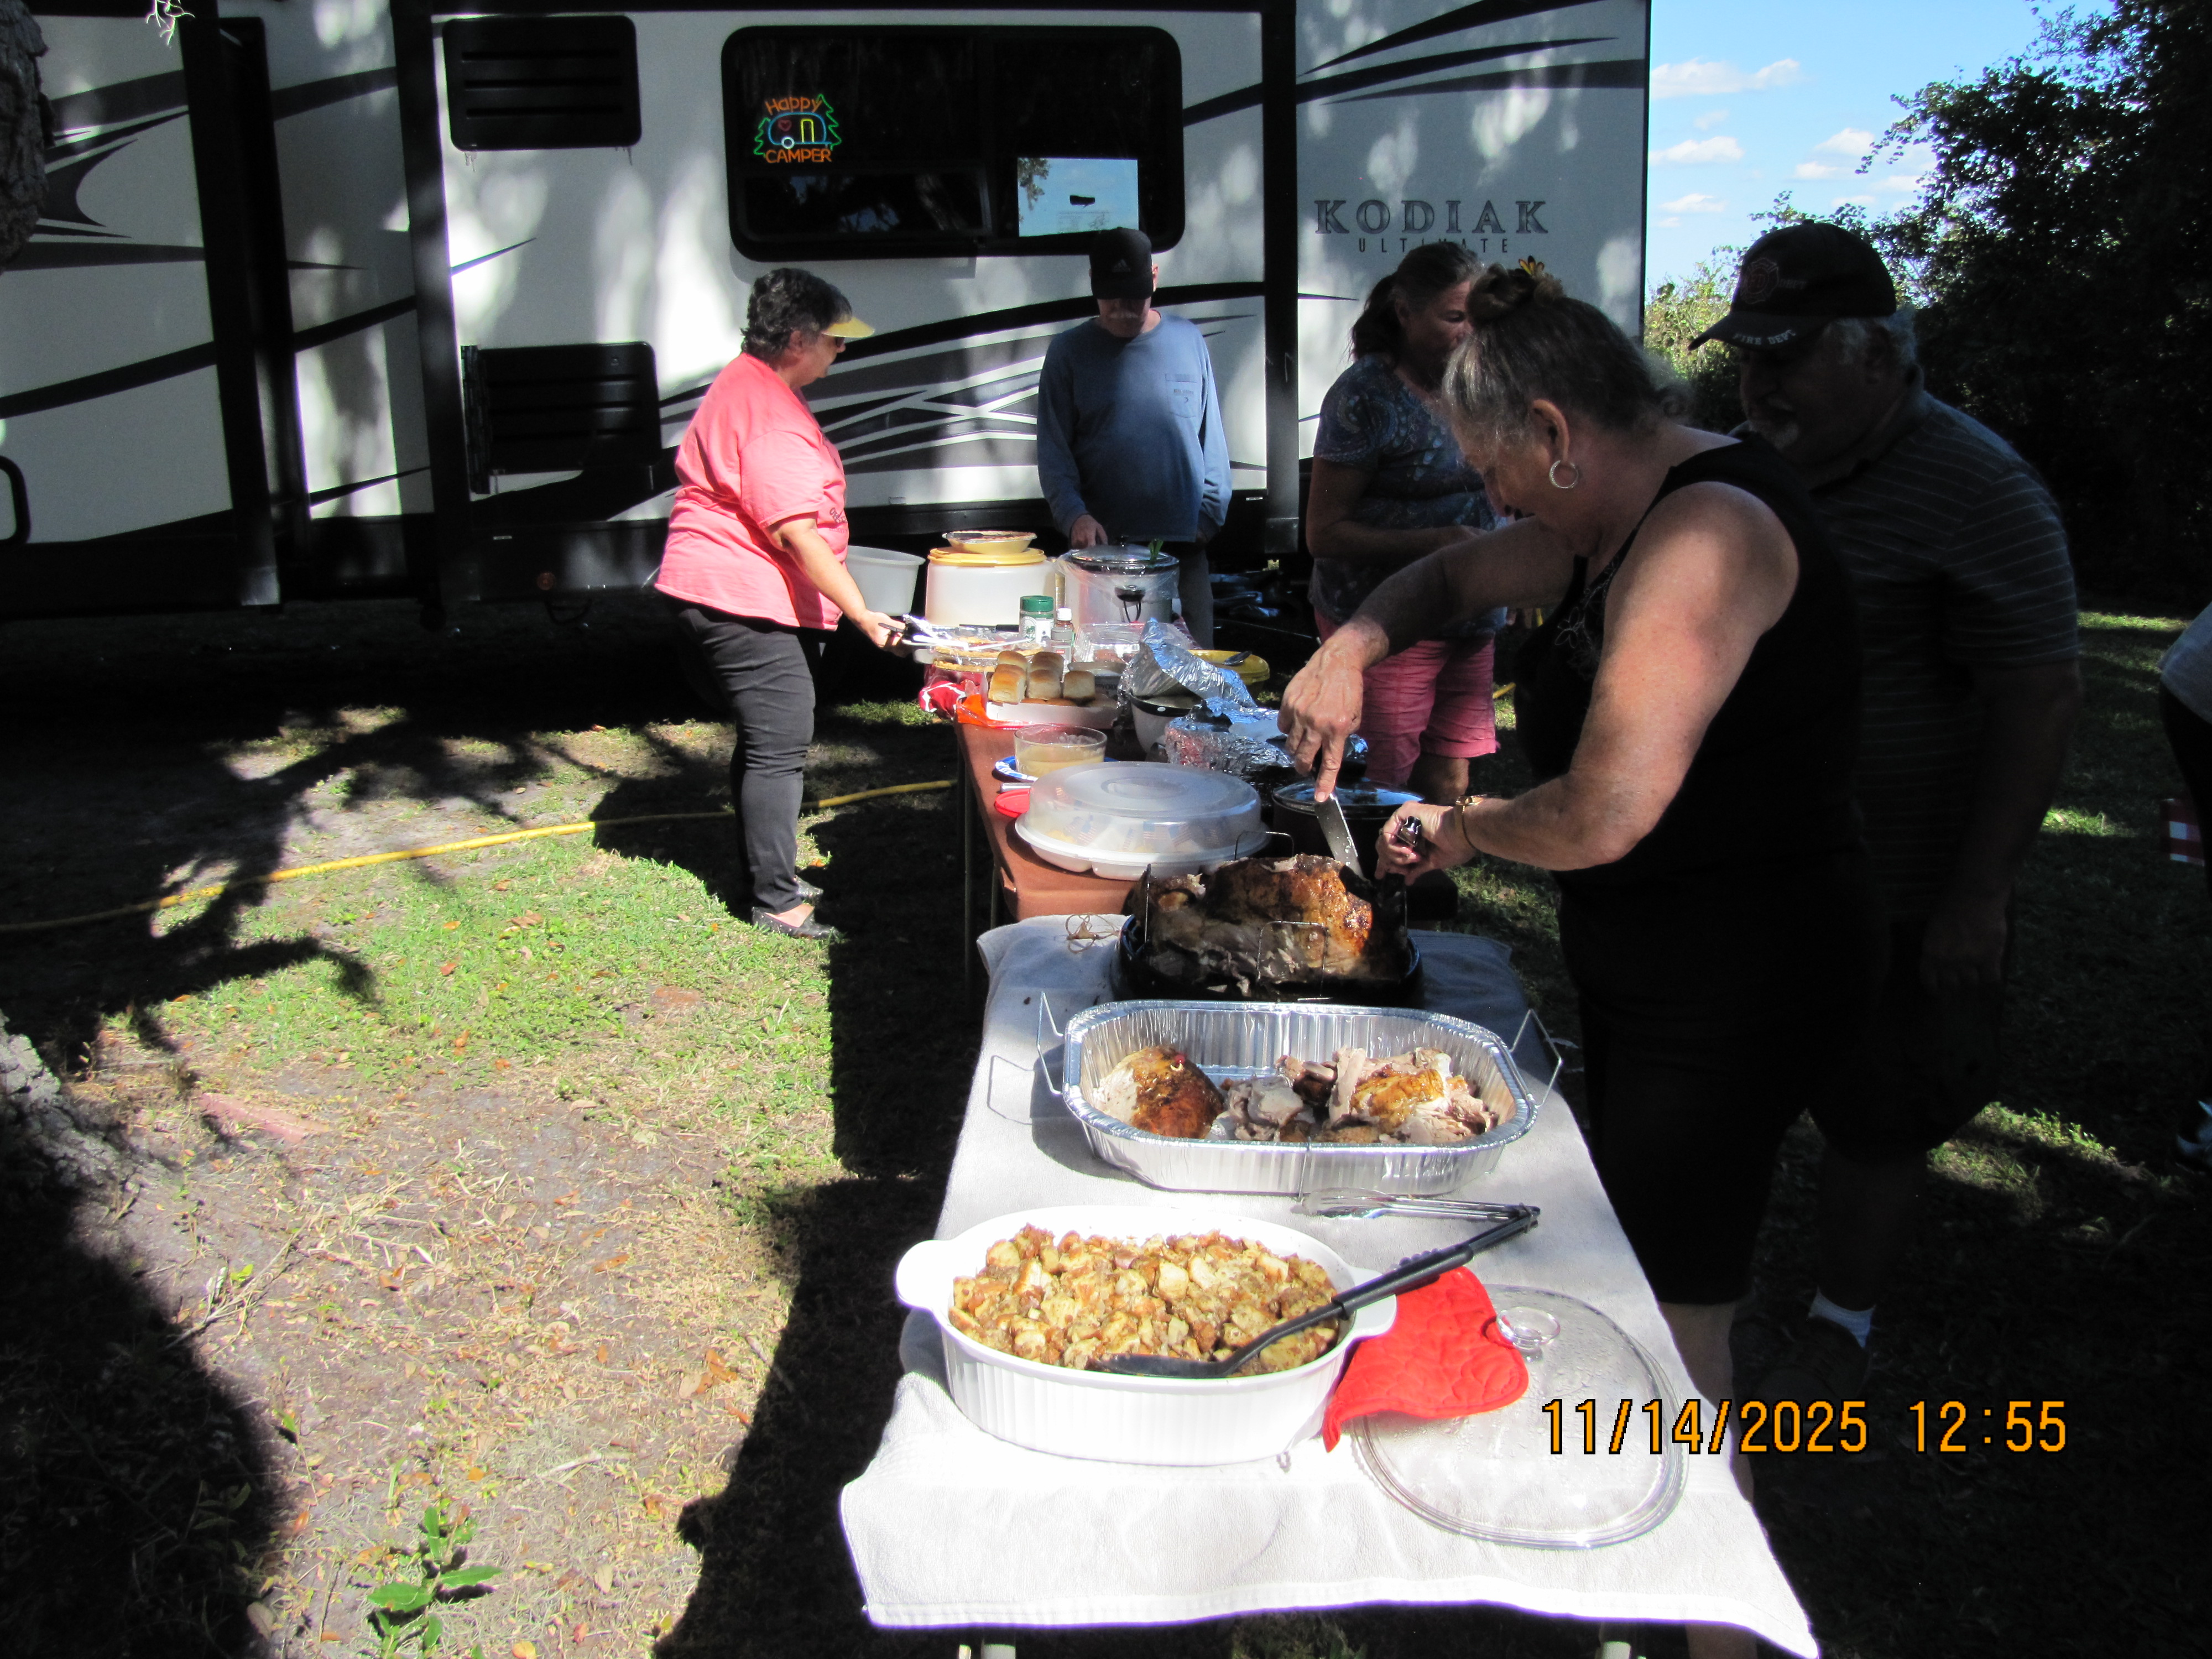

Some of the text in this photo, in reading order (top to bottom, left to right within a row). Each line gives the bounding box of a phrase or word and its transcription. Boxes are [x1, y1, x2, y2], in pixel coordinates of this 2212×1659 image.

[765, 97, 823, 116] Happy
[765, 148, 832, 164] CAMPER
[1314, 199, 1548, 234] KODIAK
[1732, 329, 1796, 345] FIRE DEPT
